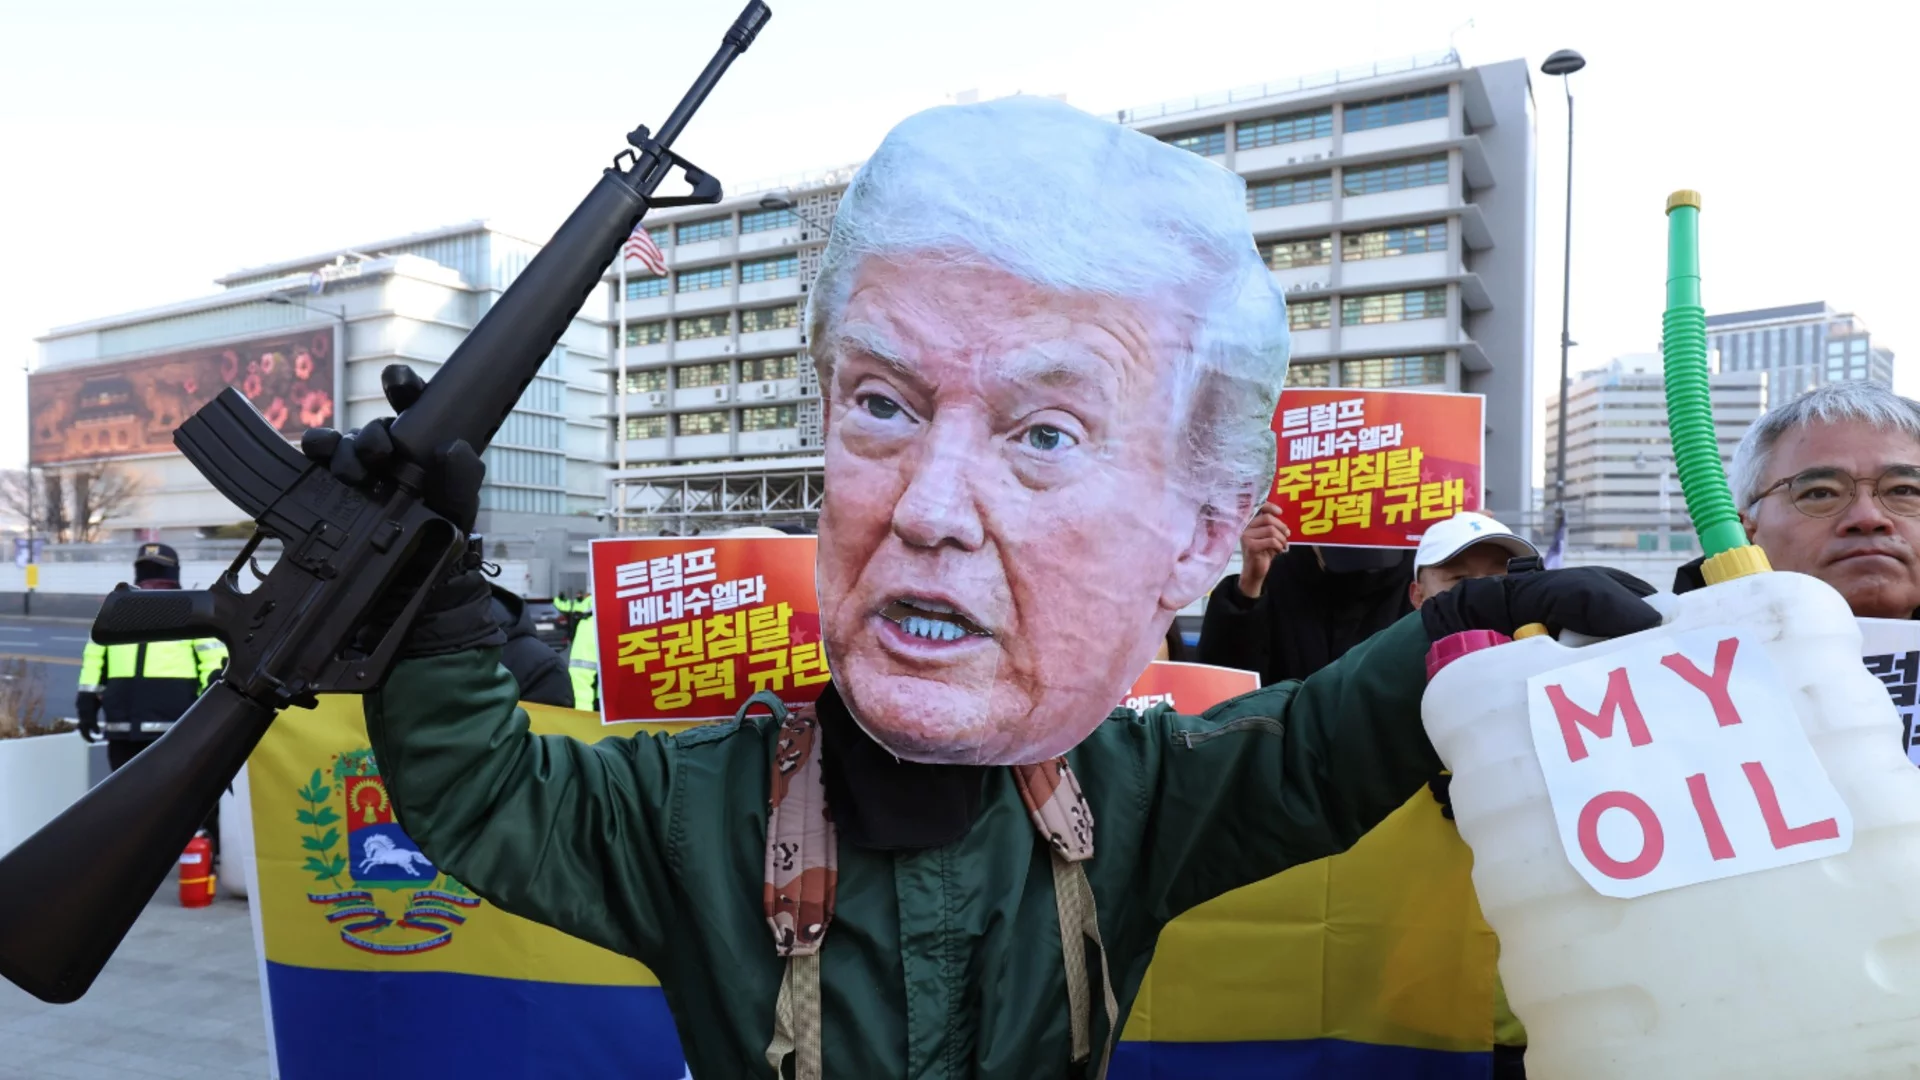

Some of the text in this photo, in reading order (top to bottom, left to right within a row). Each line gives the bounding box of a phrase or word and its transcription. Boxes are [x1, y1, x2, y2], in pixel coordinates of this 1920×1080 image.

[1282, 398, 1365, 438] 트럼프
[1289, 423, 1403, 462] 베네수엘라
[1277, 446, 1424, 501] 주권침탈
[1300, 478, 1465, 536] 강력 규탄!
[616, 547, 717, 599] 트럼프
[628, 575, 767, 627] 베네수엘라
[618, 602, 793, 674] 주권침탈
[651, 658, 737, 711] 강력
[1544, 637, 1743, 763] MY
[1577, 761, 1841, 880] OIL
